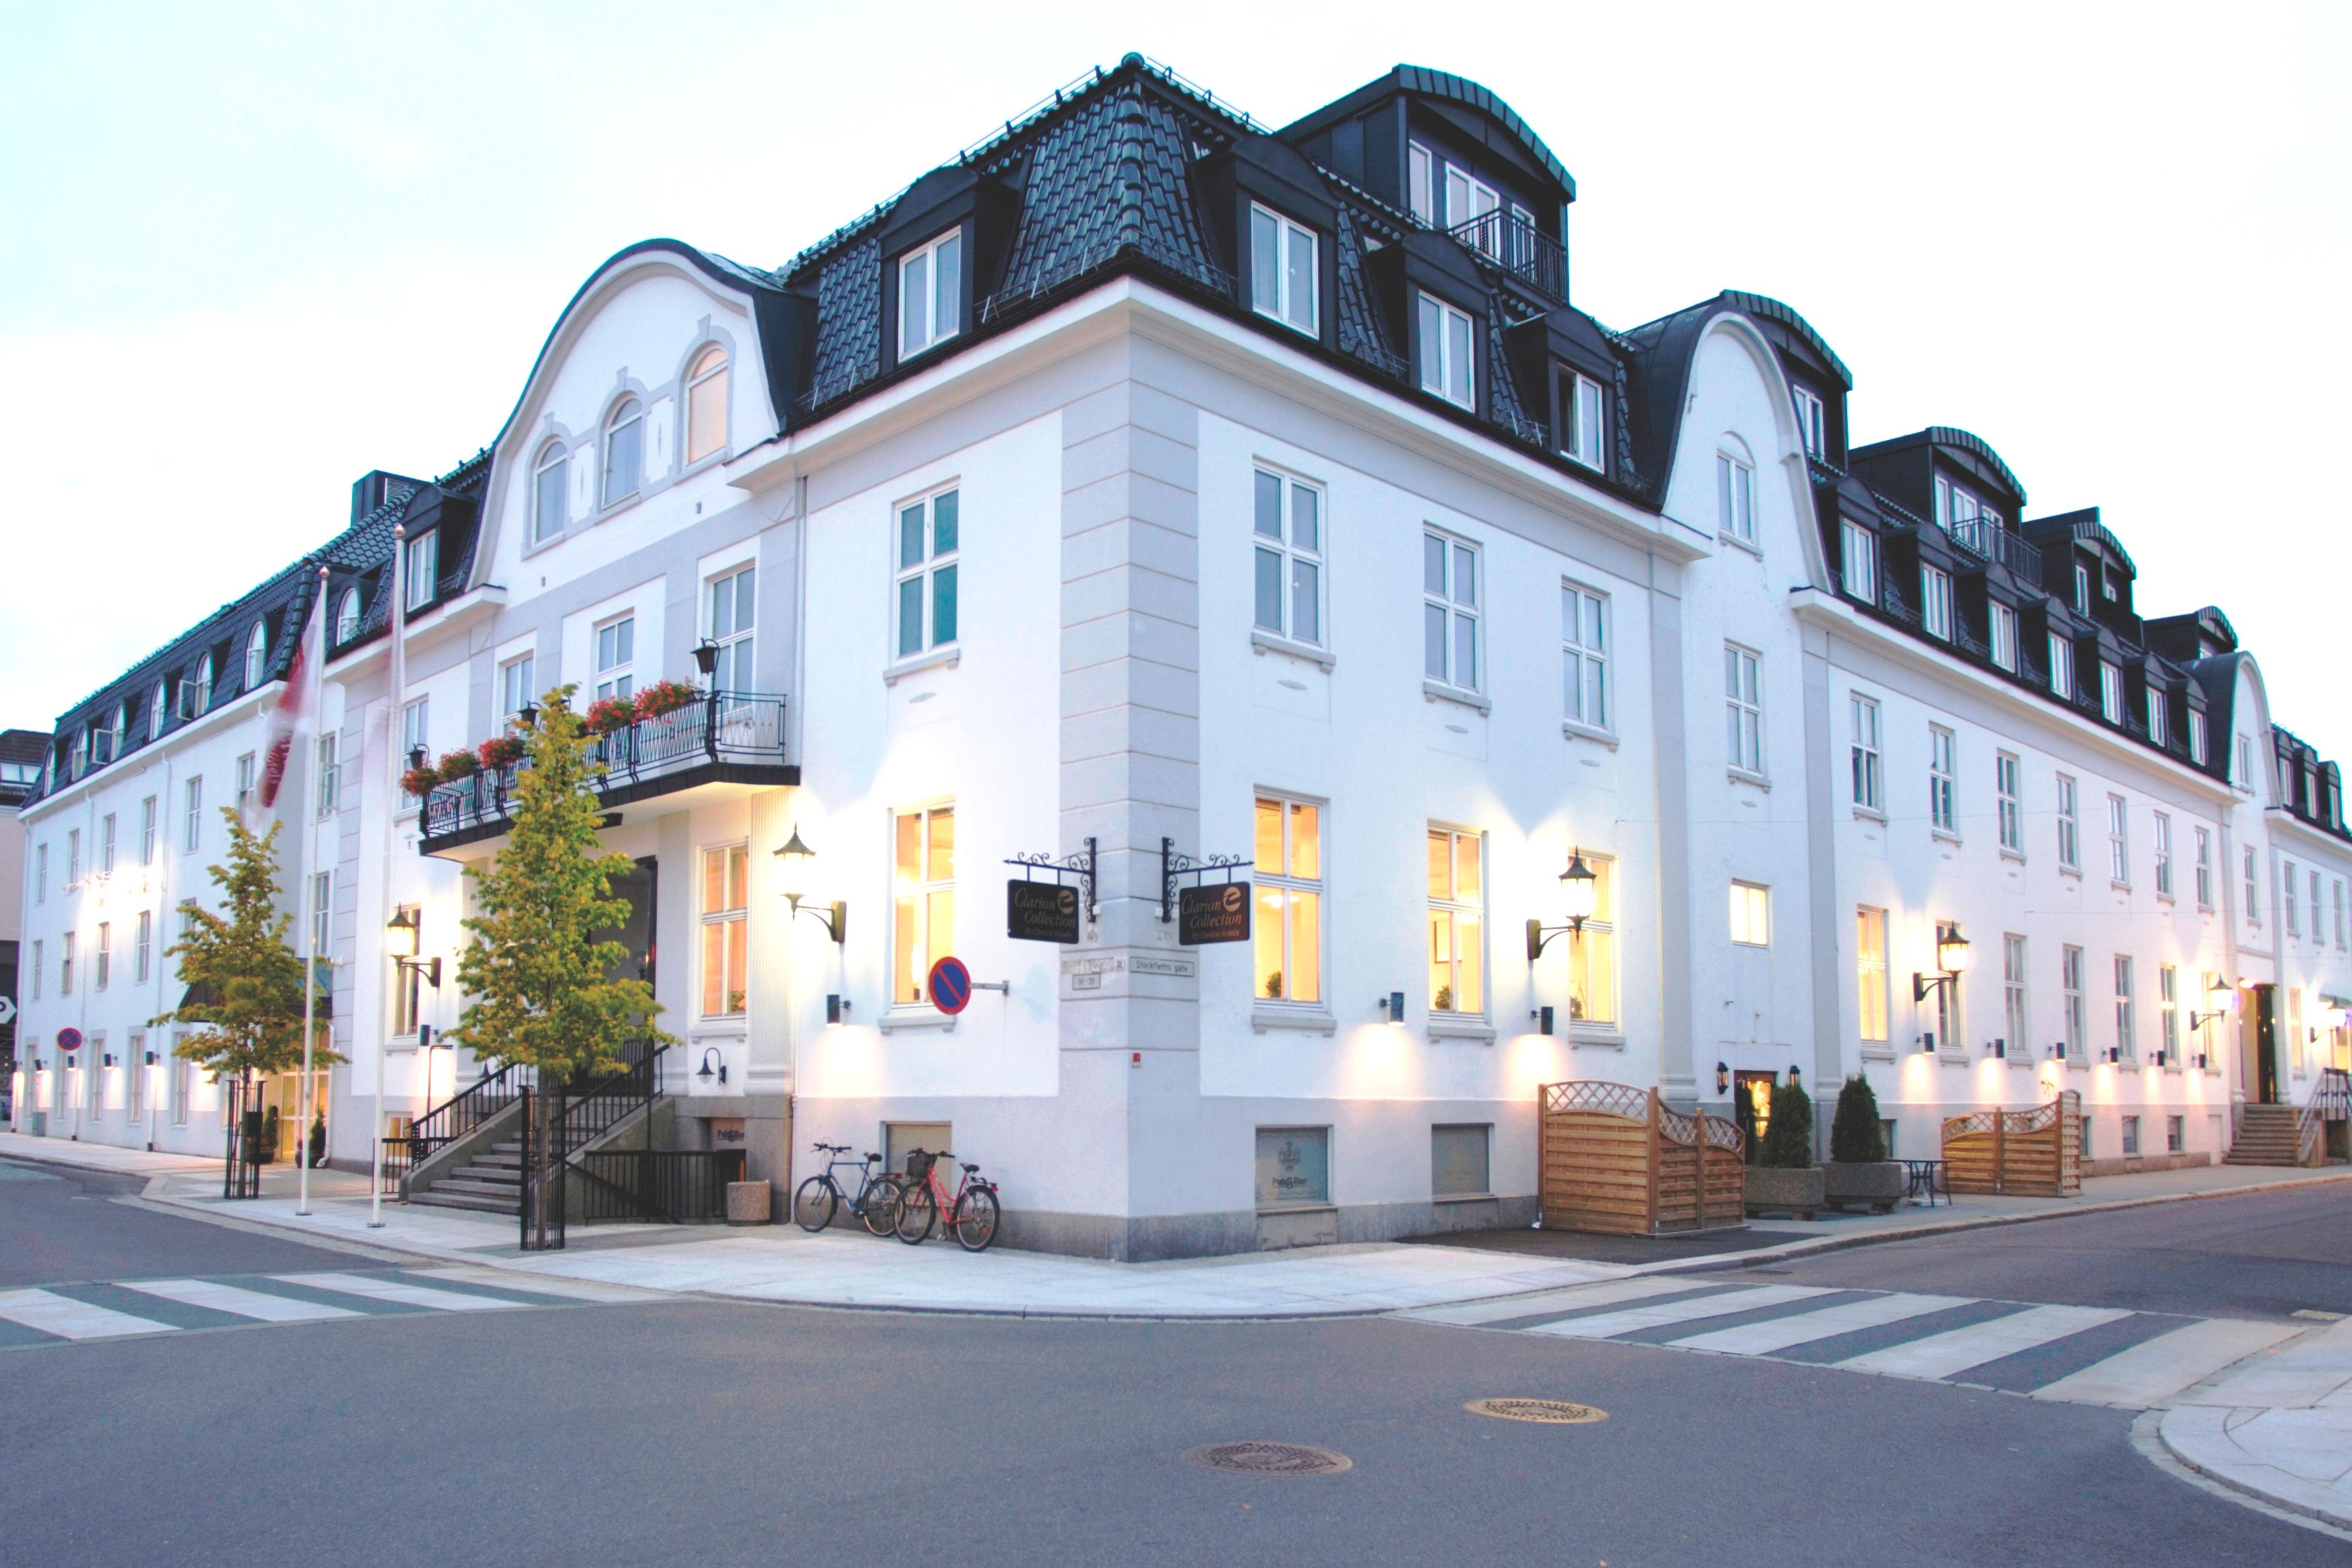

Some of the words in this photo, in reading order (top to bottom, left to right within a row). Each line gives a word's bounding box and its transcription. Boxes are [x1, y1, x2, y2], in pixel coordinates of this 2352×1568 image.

[1014, 888, 1055, 910] Clarion
[1181, 894, 1222, 915] Clarion
[1024, 910, 1076, 928] Collection
[1190, 913, 1242, 929] Collection
[1174, 965, 1188, 973] gate
